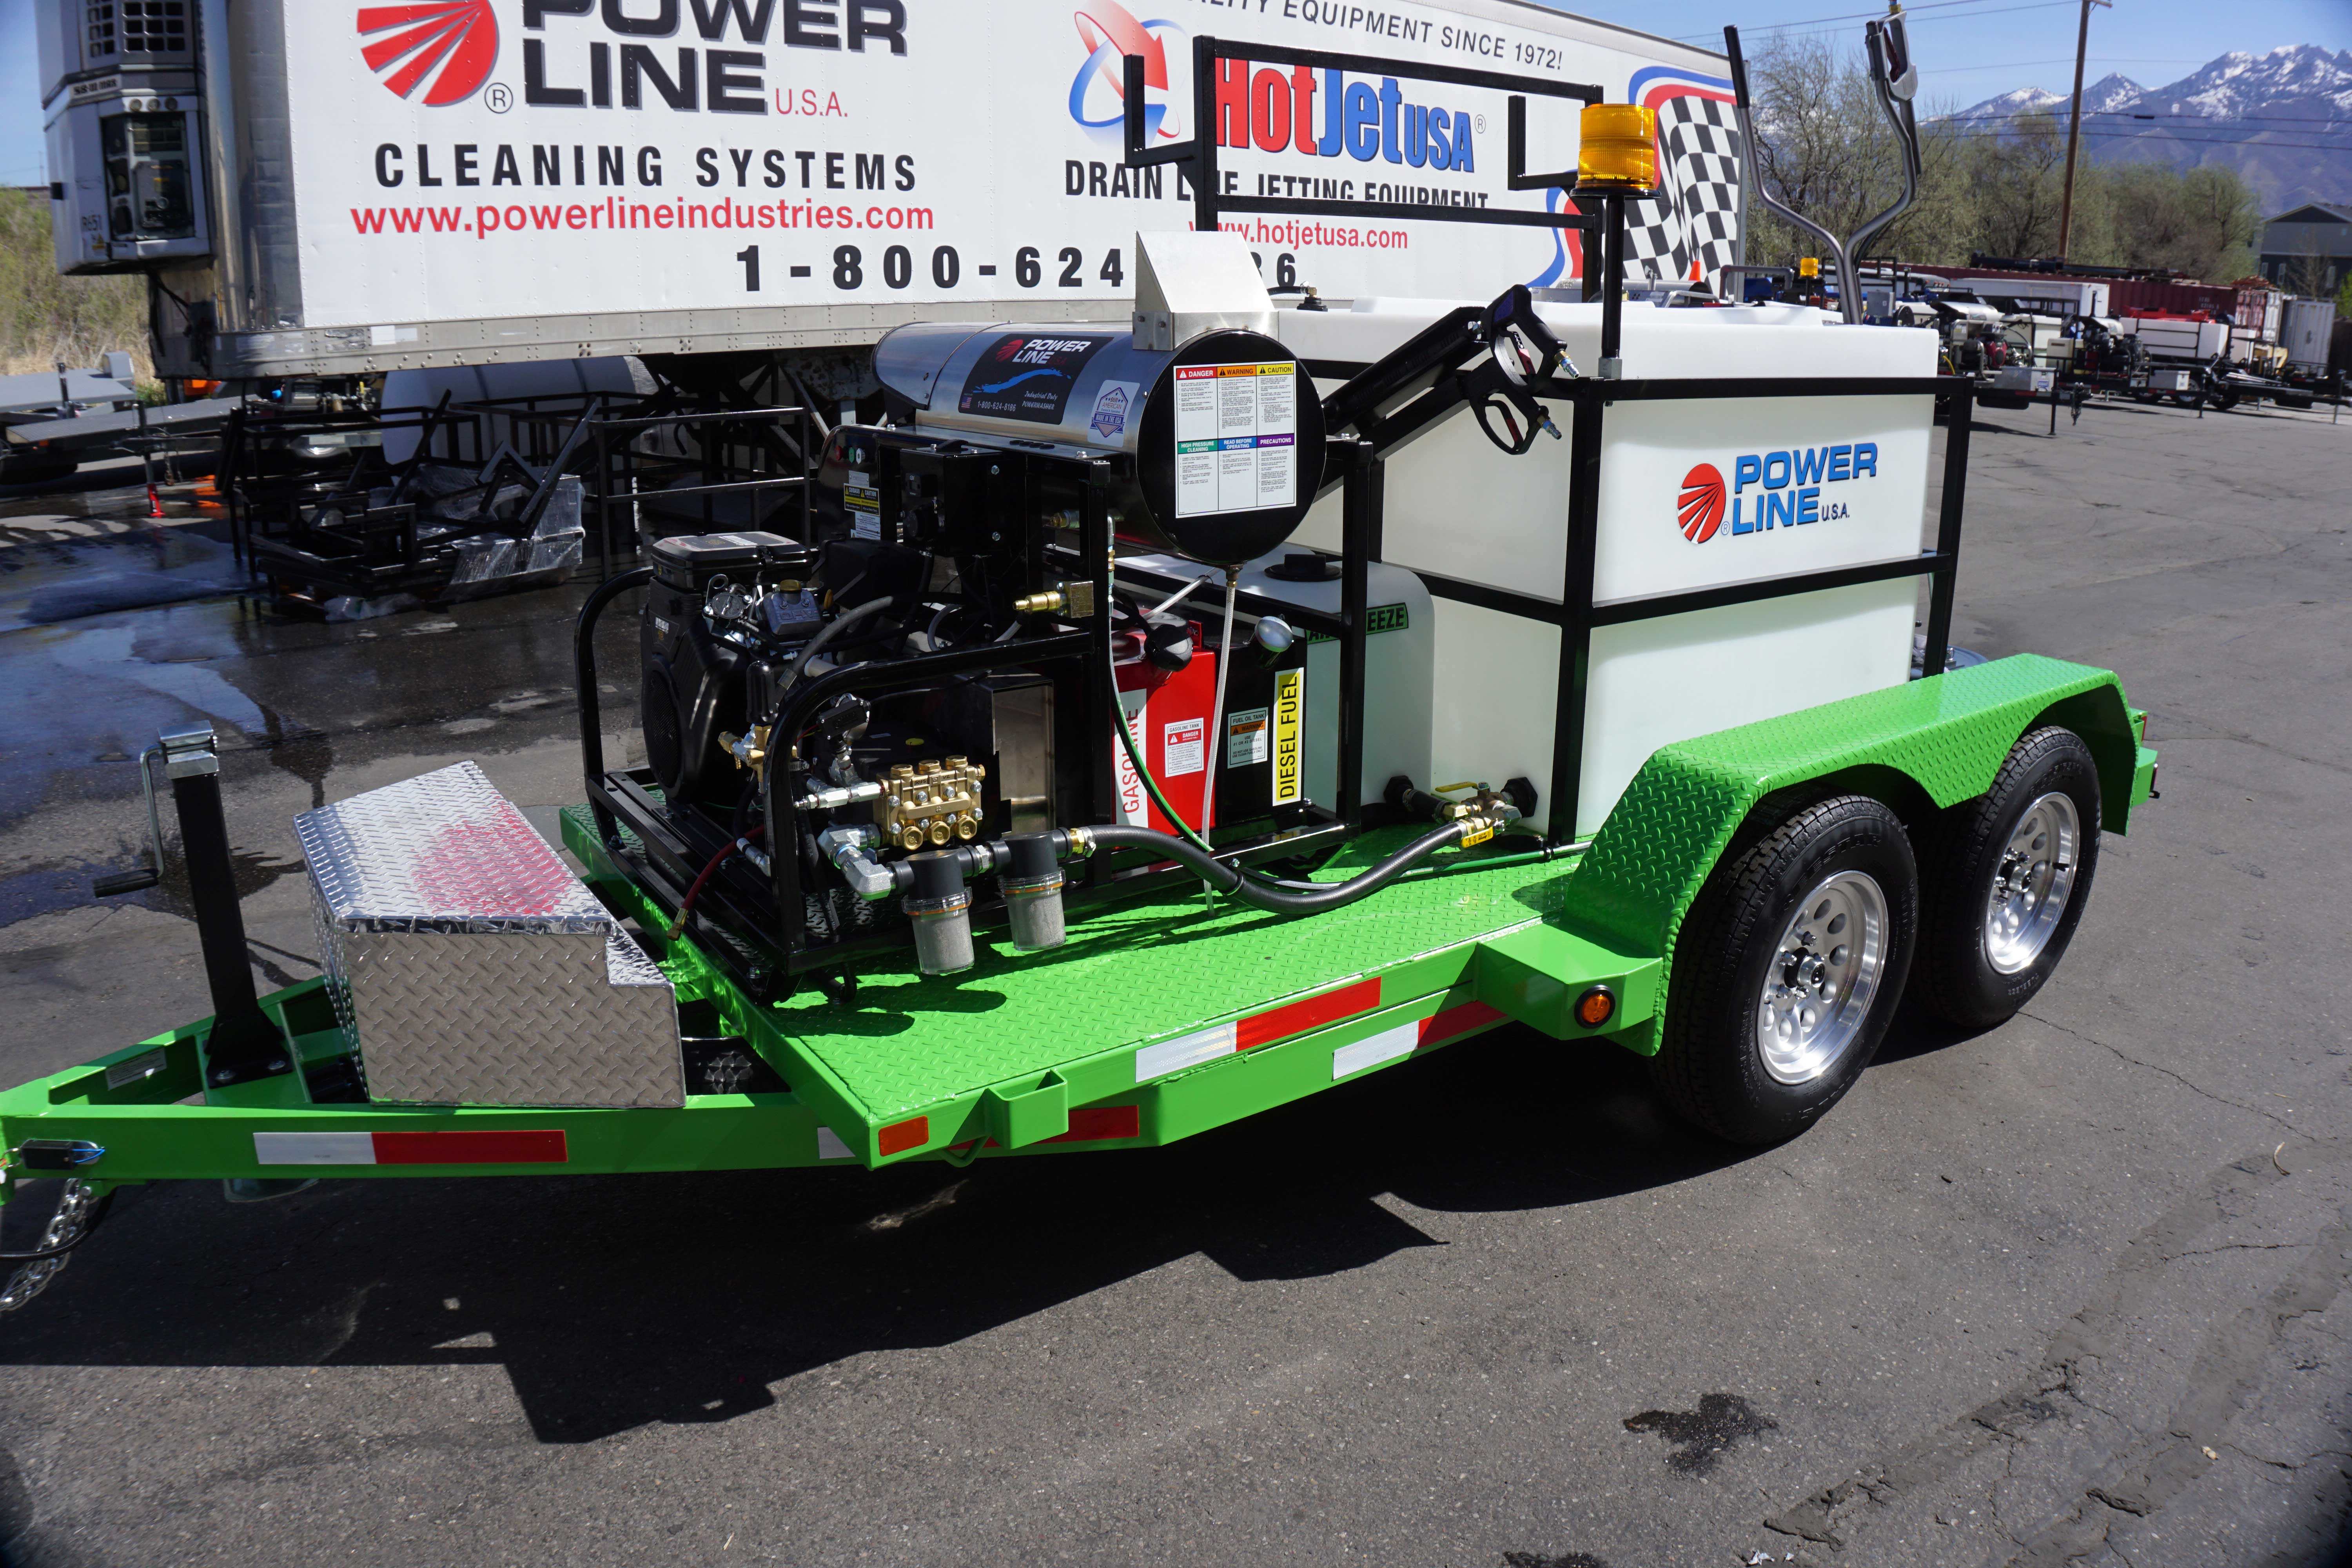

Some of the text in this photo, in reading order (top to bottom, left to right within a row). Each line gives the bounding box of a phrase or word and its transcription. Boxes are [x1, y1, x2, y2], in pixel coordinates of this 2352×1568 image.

[1283, 0, 1563, 70] EQUIPMENT SINCE 1972!
[523, 38, 848, 117] LINE U.S.A.
[375, 143, 915, 191] CLEANING SYSTEMS
[1065, 160, 1162, 200] DRAIN
[350, 196, 934, 240] www.powerlineindustries.com
[1188, 216, 1408, 250] w.hotjetusa.com
[1012, 350, 1055, 364] LINE
[1024, 339, 1091, 352] POWER
[977, 400, 1016, 412] 1-800-624-8186
[1022, 400, 1055, 410] POWERWASHER
[1024, 390, 1058, 401] Industrial Duty
[1734, 442, 1878, 494] POWER
[1733, 487, 1850, 536] LINE U.S.A.
[1241, 723, 1263, 731] WARNING
[1280, 676, 1297, 799] DIESEL FUEL
